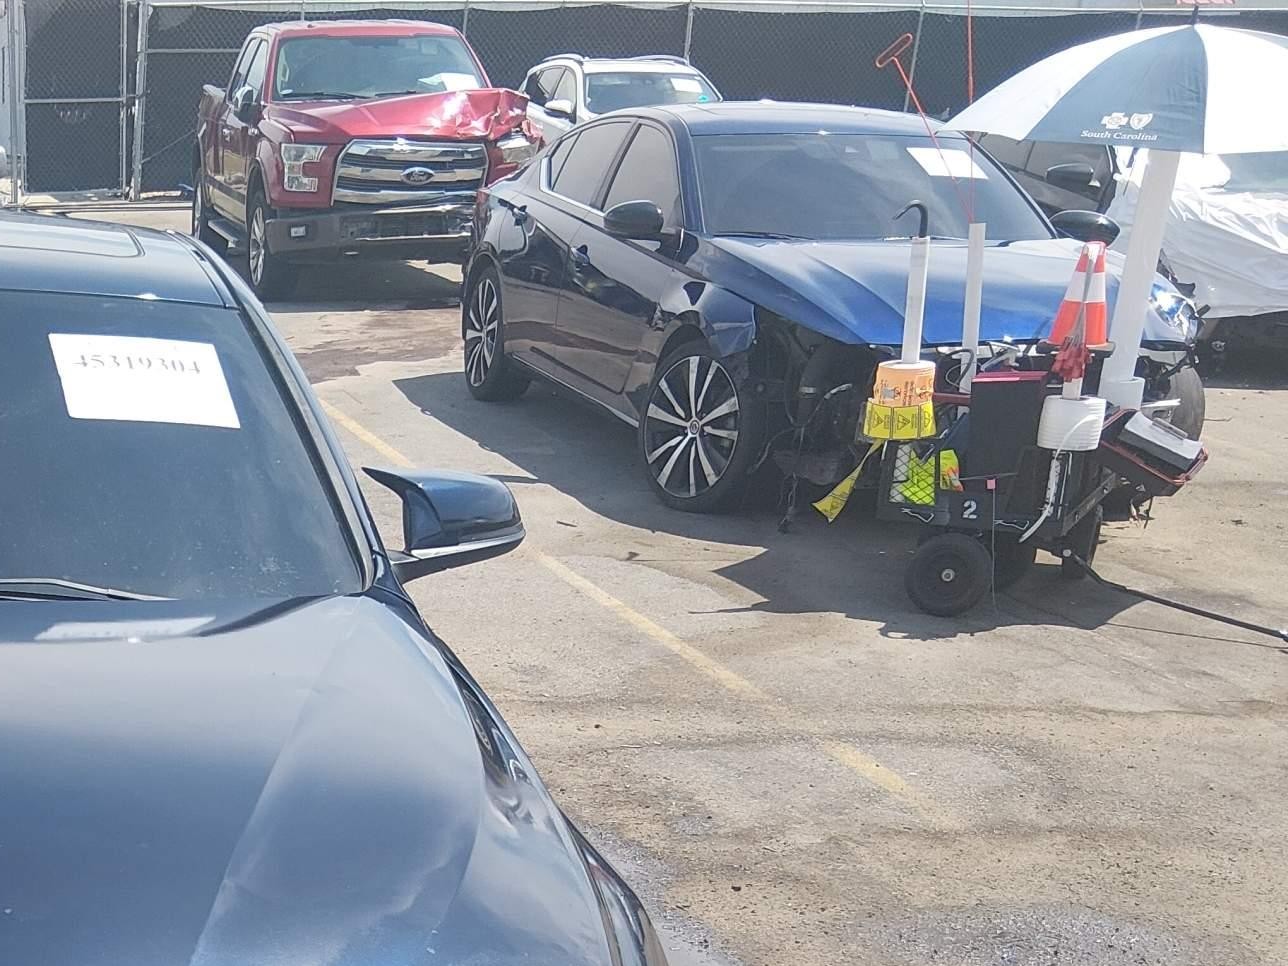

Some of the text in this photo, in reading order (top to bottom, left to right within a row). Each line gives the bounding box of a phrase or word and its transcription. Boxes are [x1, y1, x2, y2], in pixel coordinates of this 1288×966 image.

[1080, 130, 1159, 141] South Carolina
[963, 500, 978, 519] 2
